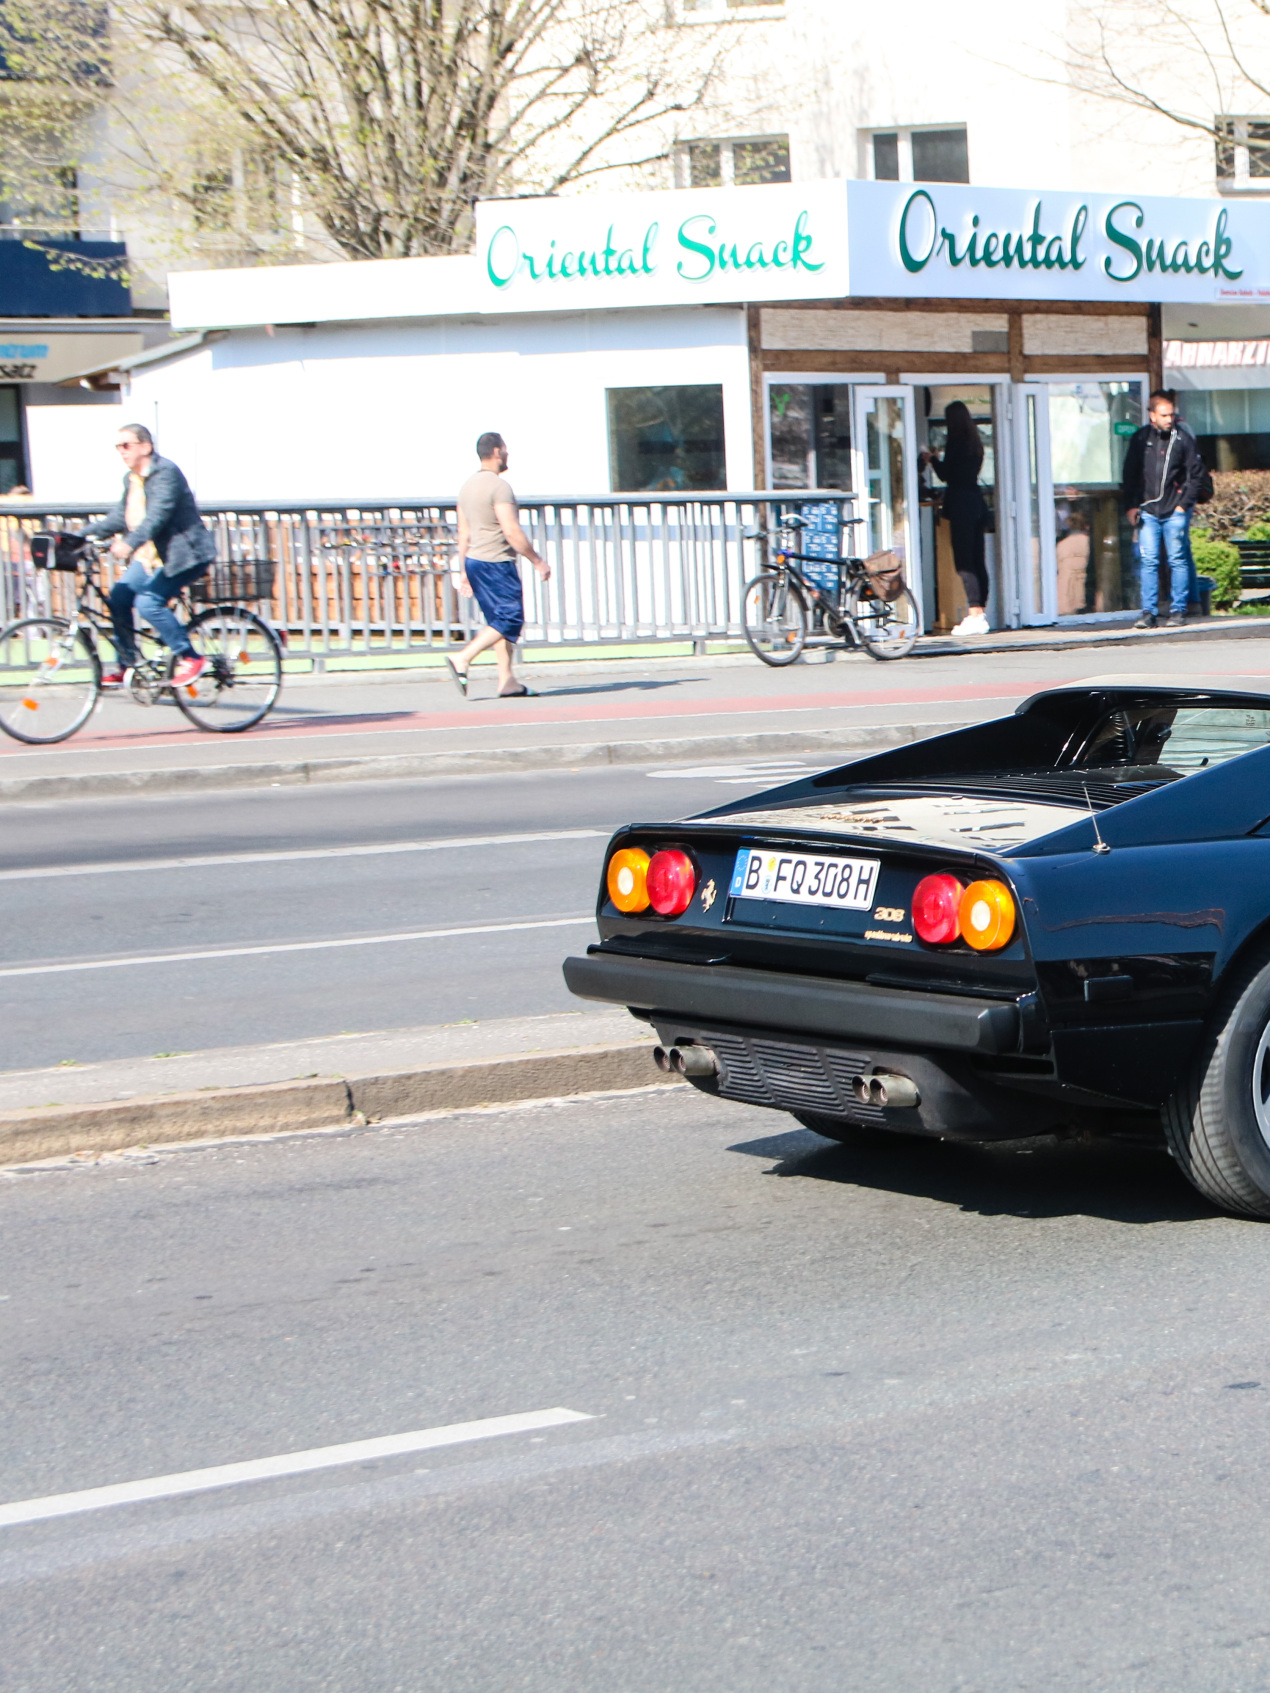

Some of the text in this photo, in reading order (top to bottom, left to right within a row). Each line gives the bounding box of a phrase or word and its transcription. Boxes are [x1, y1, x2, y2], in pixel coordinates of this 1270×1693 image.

[487, 210, 826, 287] Oriental Snack
[900, 189, 1244, 282] Oriental Snack
[745, 855, 763, 890] B
[873, 906, 906, 923] 308
